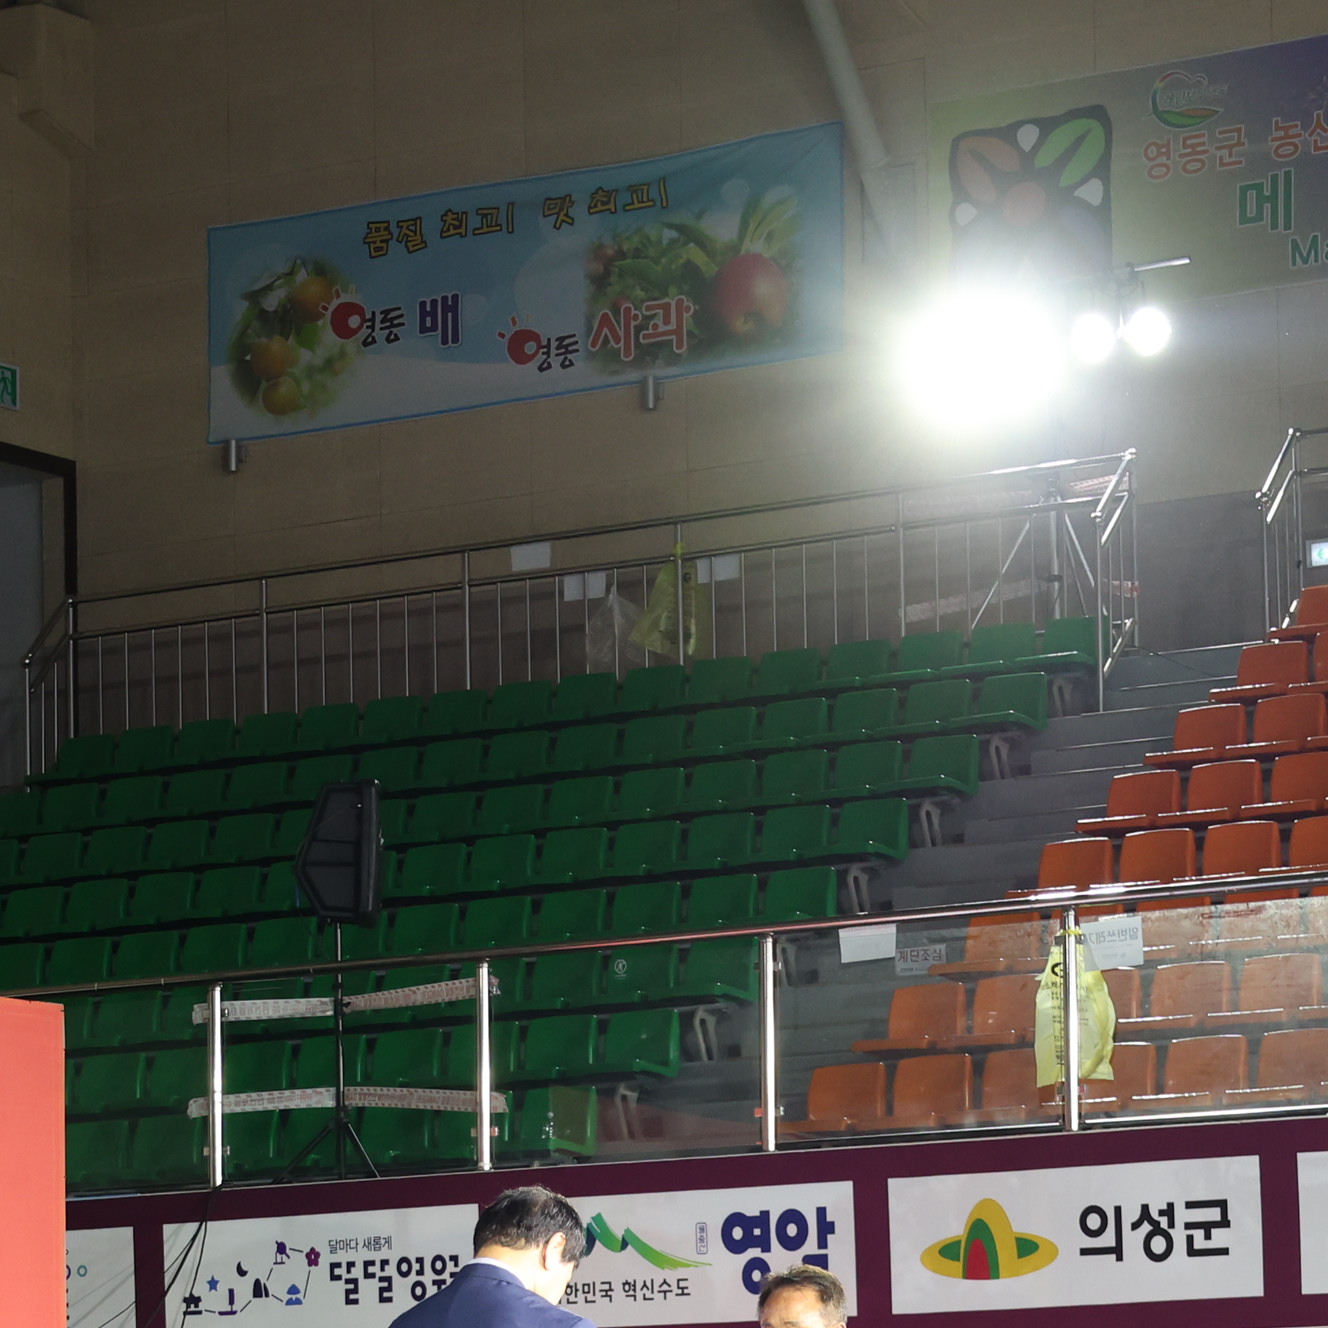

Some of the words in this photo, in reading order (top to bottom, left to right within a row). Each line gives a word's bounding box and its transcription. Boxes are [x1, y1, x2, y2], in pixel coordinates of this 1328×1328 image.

[1143, 124, 1246, 181] 영동군
[363, 217, 427, 258] 품질
[543, 195, 574, 230] 맛
[328, 300, 406, 348] 영동
[417, 292, 462, 347] 배
[506, 327, 580, 373] 영동
[588, 296, 694, 362] 사과
[328, 1238, 359, 1255] 달마다
[361, 1235, 394, 1253] 새롭게
[1079, 1198, 1231, 1263] 의성군
[556, 1280, 614, 1304] 한민국
[622, 1278, 691, 1302] 혁신수도
